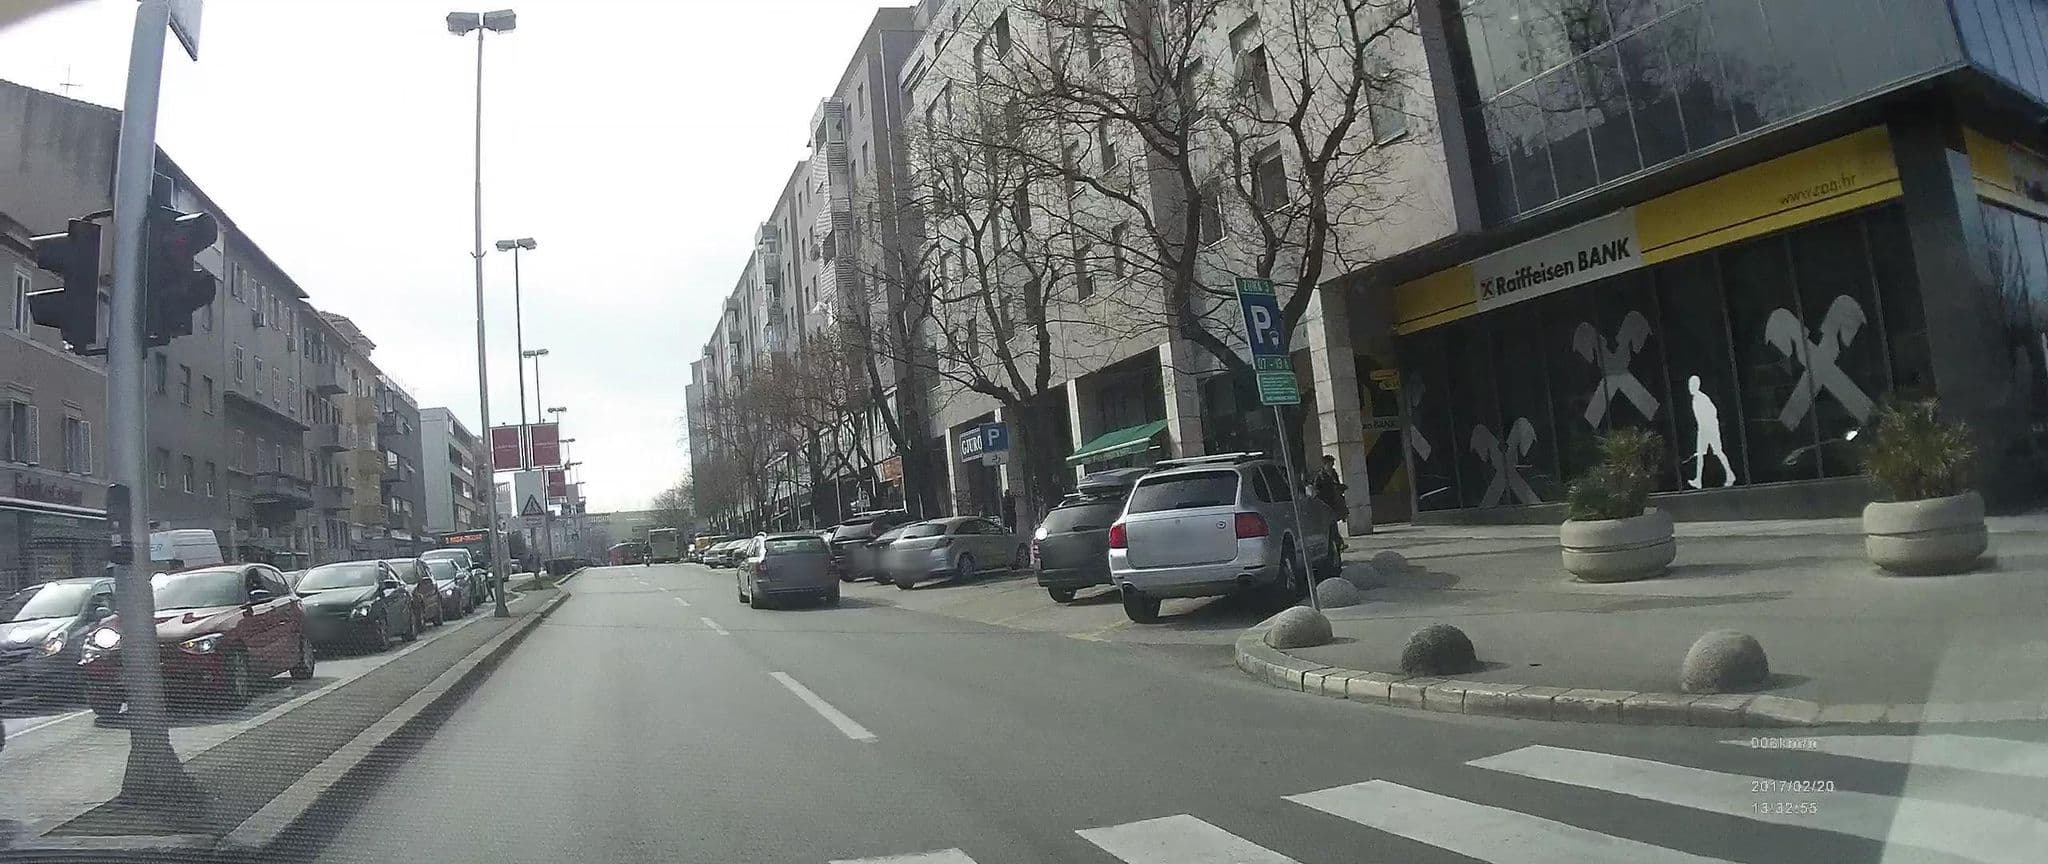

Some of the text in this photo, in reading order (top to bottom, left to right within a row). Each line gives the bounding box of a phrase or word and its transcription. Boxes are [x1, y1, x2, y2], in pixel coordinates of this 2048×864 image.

[1496, 237, 1631, 296] Raiffeisen BANK
[1250, 305, 1272, 344] P
[987, 428, 1000, 447] P
